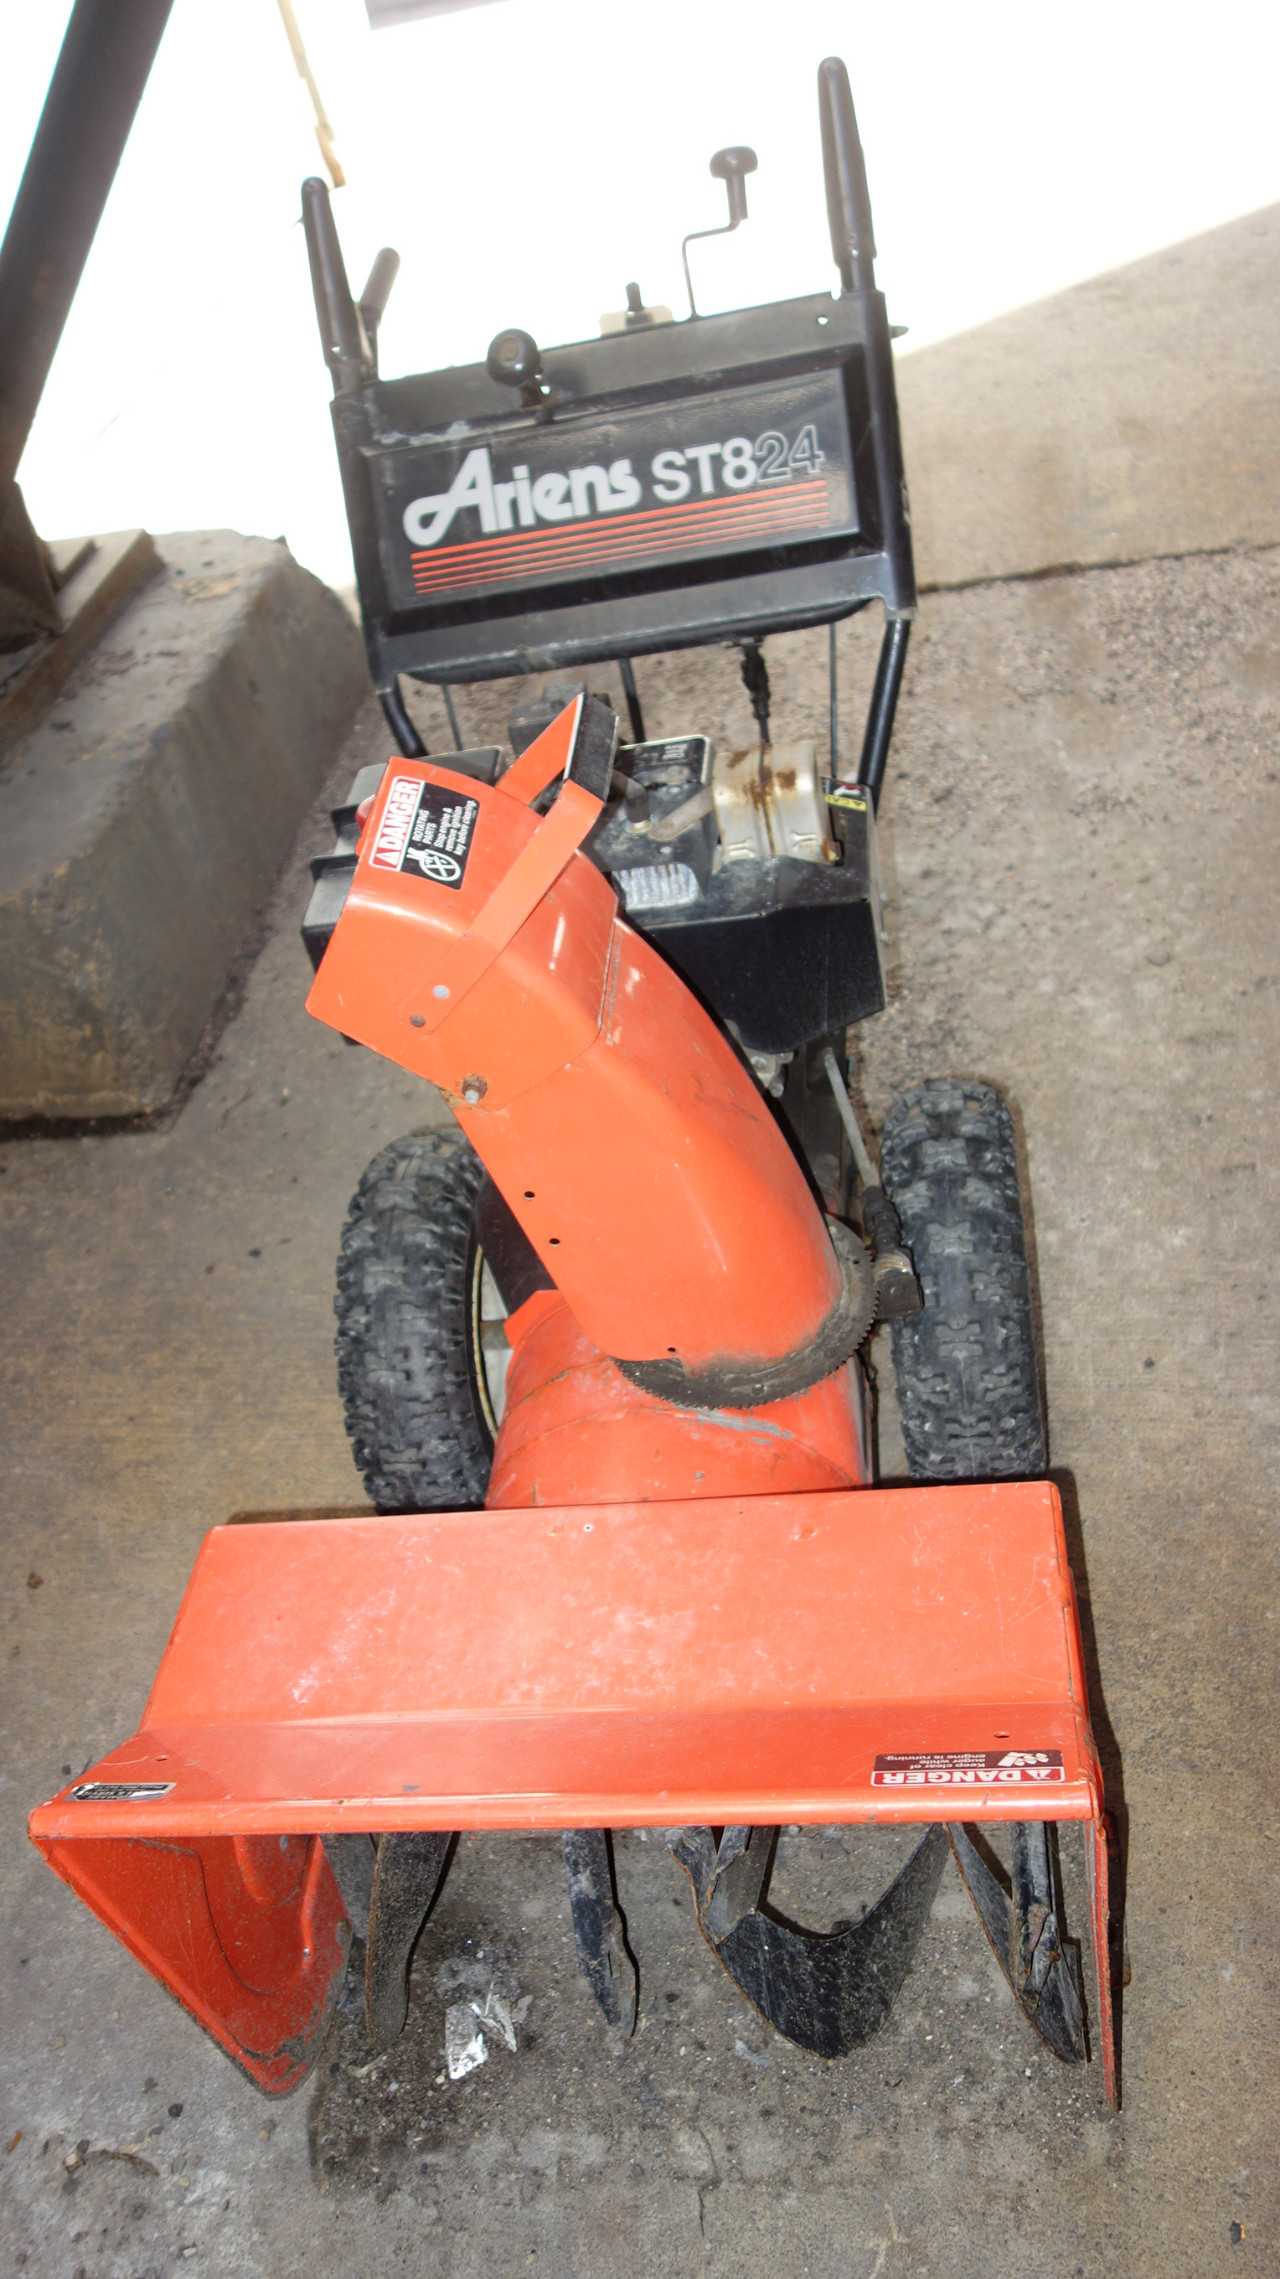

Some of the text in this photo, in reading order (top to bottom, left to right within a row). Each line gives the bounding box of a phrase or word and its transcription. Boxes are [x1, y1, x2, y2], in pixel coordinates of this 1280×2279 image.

[403, 425, 825, 546] Ariens ST824
[381, 779, 419, 852] DANGER
[412, 809, 429, 841] ROTATING
[439, 813, 452, 833] engine
[423, 822, 437, 844] PARTS
[445, 805, 464, 851] remove ignition
[457, 823, 469, 842] before
[434, 832, 446, 847] Stop
[454, 843, 466, 855] key
[883, 1770, 1022, 1783] DANGER
